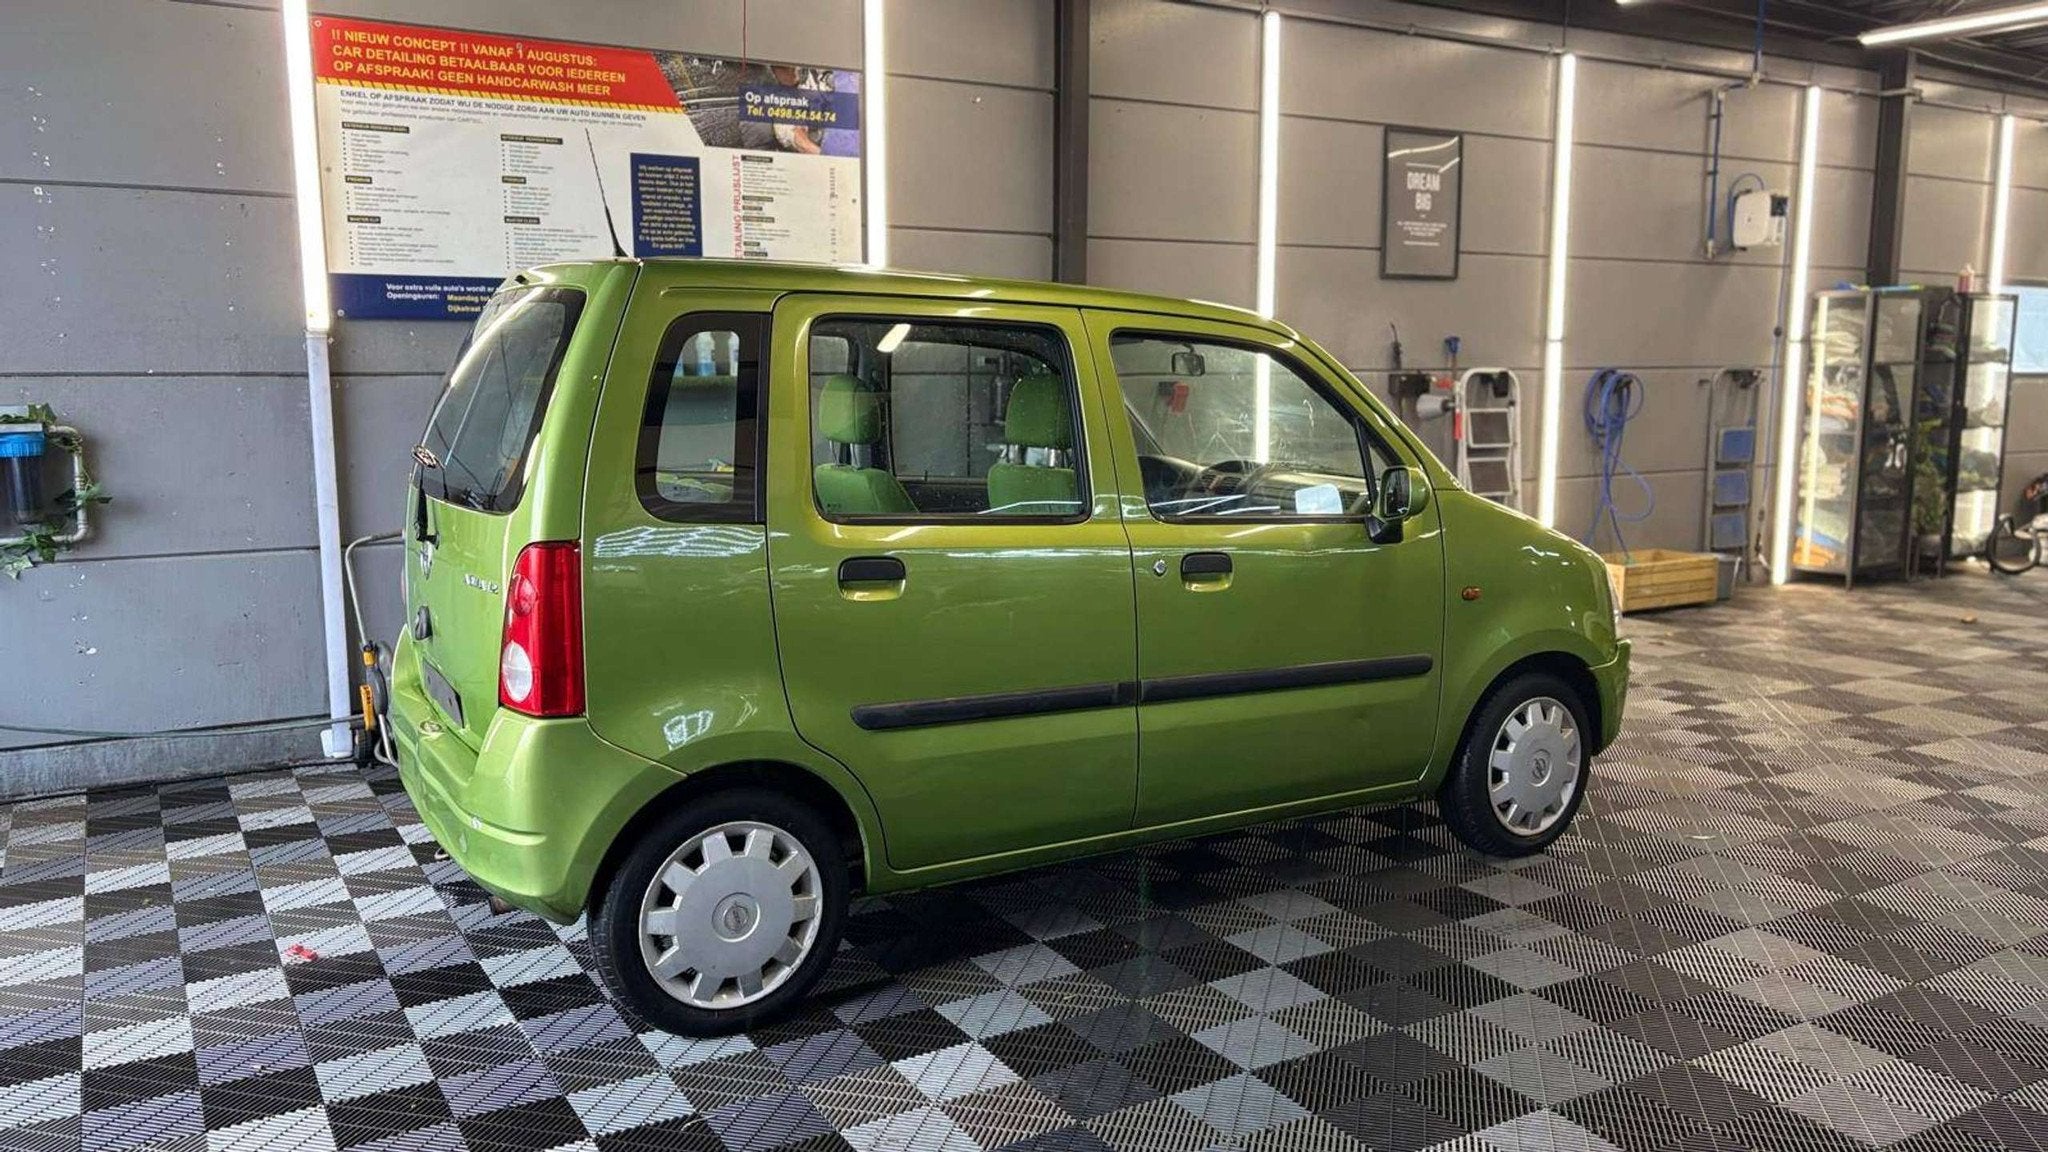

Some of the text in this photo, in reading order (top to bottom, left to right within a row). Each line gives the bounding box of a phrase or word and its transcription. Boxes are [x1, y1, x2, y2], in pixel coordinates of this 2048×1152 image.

[331, 28, 598, 67] !! NIEUW CONCEPT !! VANAF 1 AUGUSTUS:
[332, 44, 626, 84] CAR DETAILING BETAALBAAR VOOR IEDEREEN
[333, 60, 612, 96] OP AFSPRAAK! GEEN HANDCARWASH MEER
[340, 89, 368, 99] ENKEL
[383, 94, 428, 104] AFSPRAAK
[429, 97, 456, 106] ZODAT
[457, 99, 471, 108] WIJ
[472, 101, 484, 109] DE
[485, 102, 514, 111] NODIGE
[516, 105, 537, 113] ZORG
[539, 106, 555, 114] AAN
[570, 109, 590, 117] AUTO
[591, 110, 621, 119] KUNNEN
[622, 113, 646, 121] GEVEN
[744, 91, 809, 108] Op afspraak
[746, 105, 837, 123] Tel. 0498.54.54.74
[1406, 171, 1441, 191] DREAM
[1414, 193, 1432, 211] BIG
[385, 283, 403, 291] Voor
